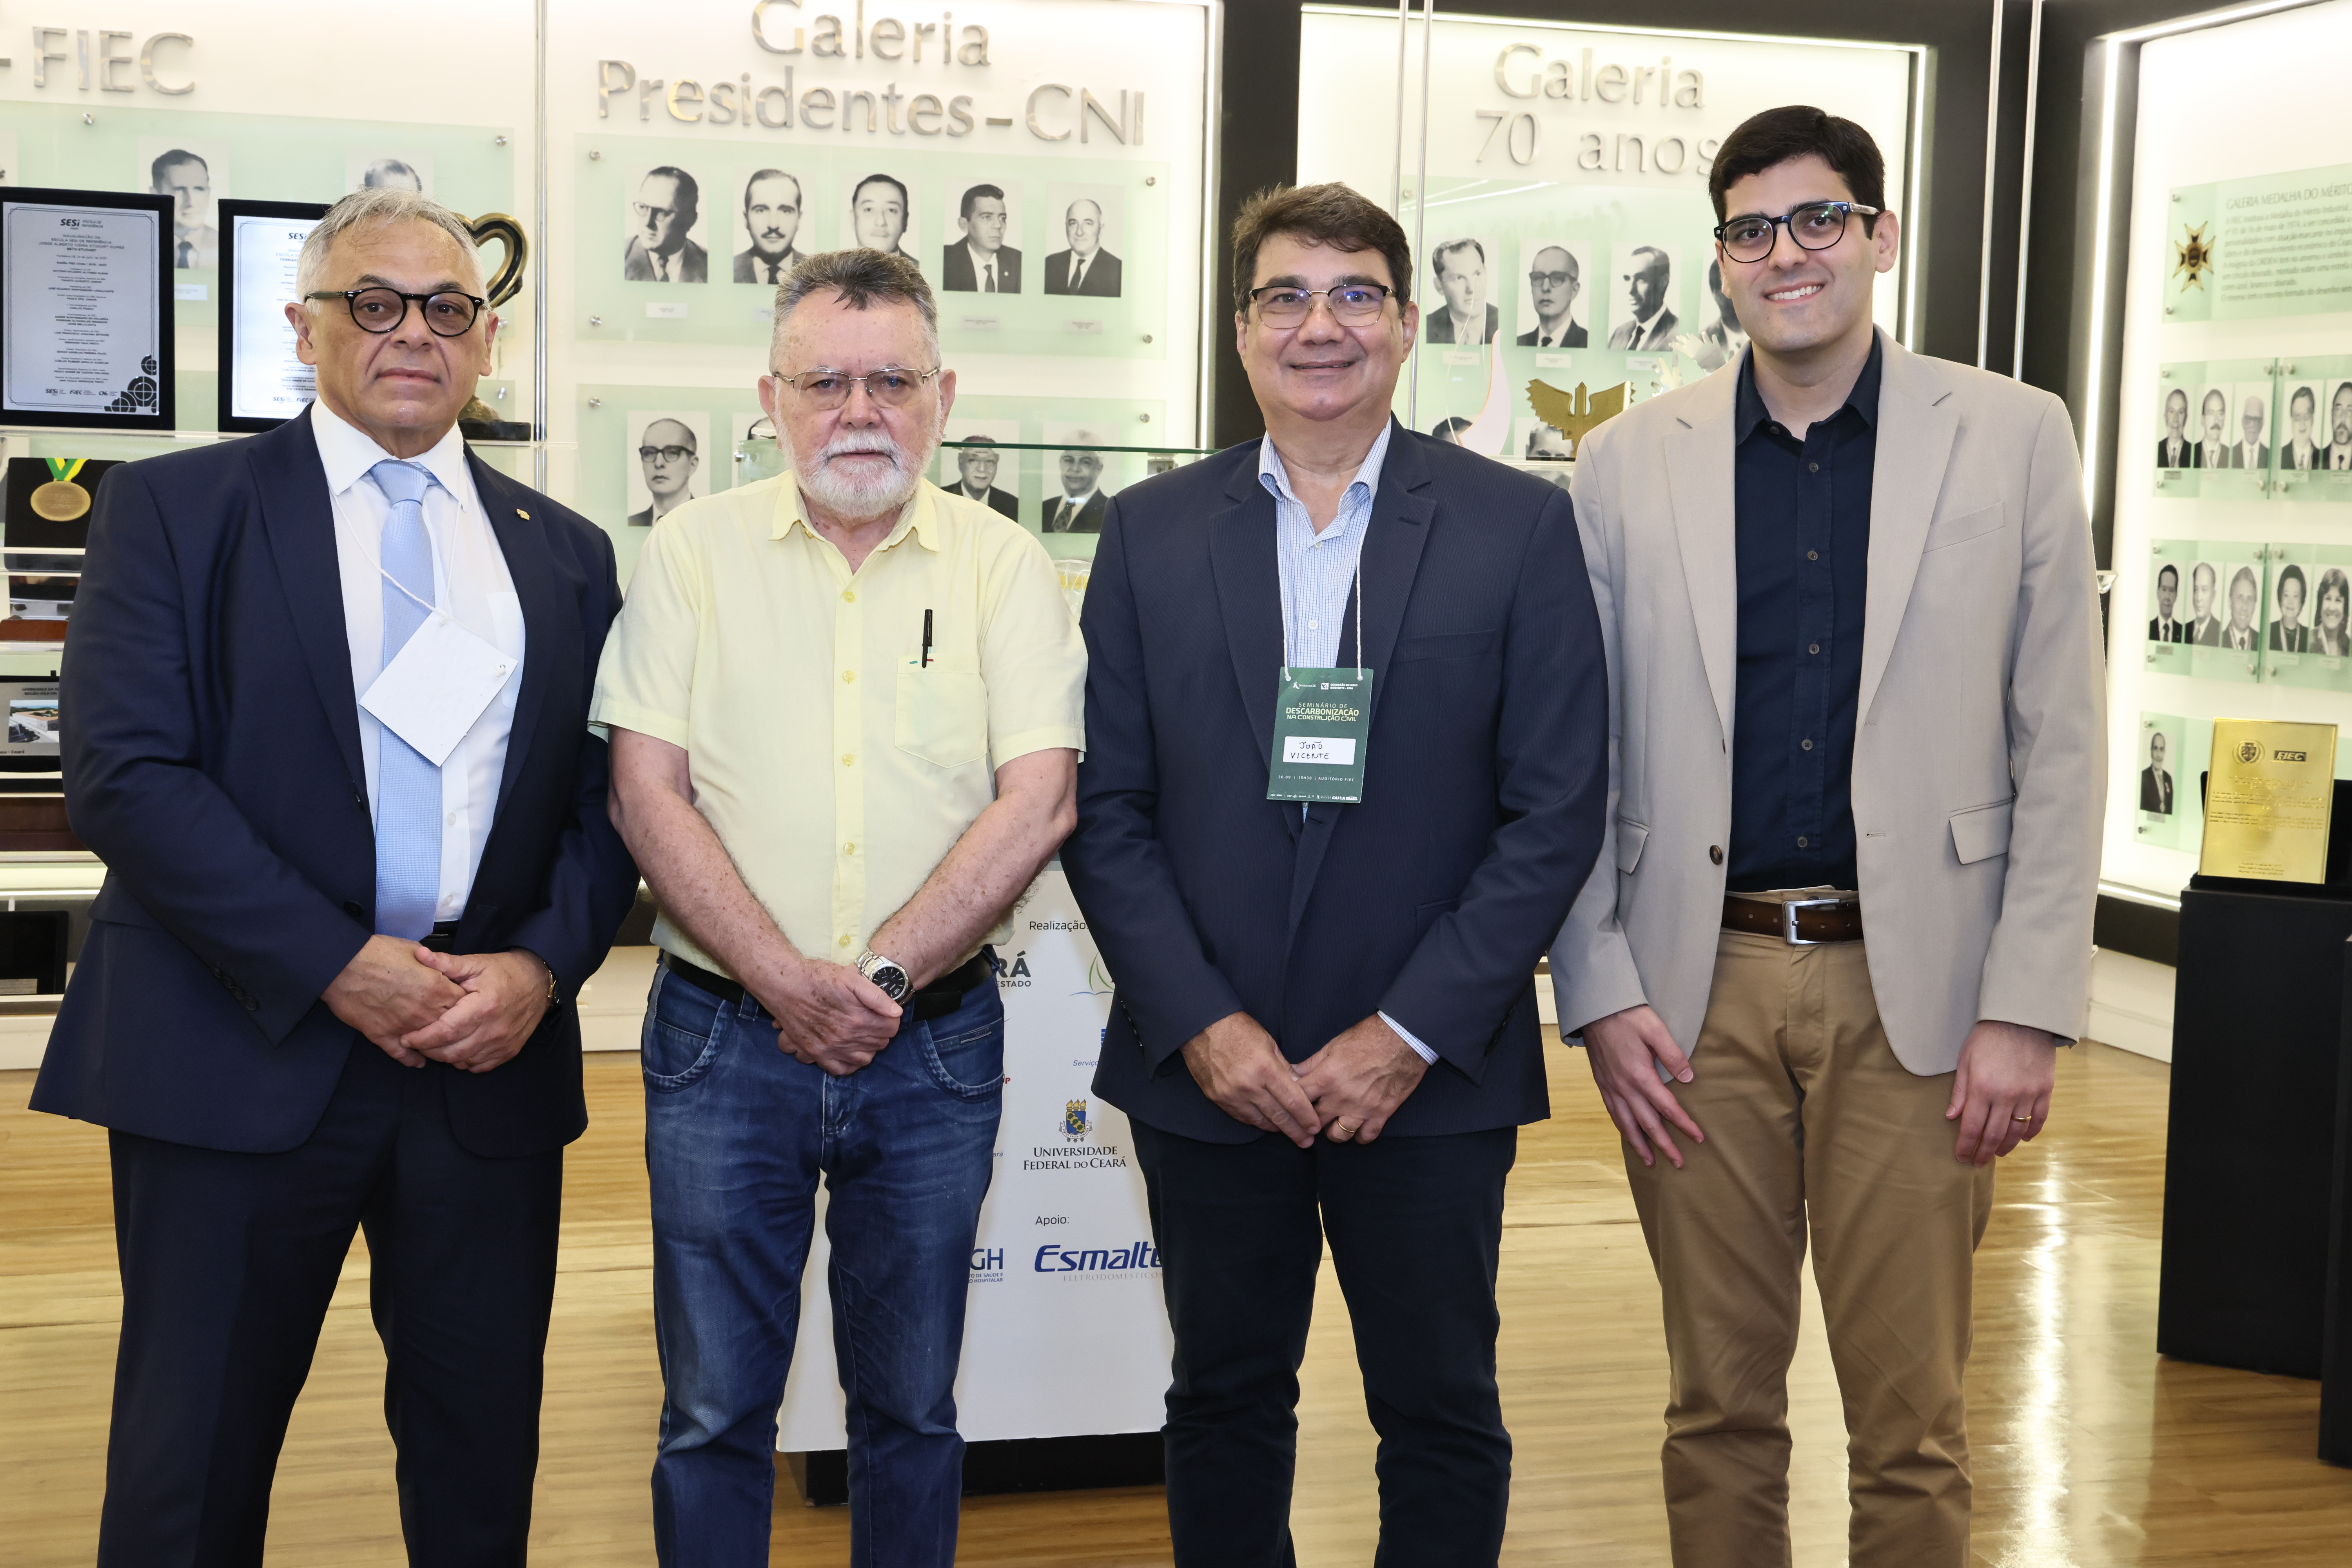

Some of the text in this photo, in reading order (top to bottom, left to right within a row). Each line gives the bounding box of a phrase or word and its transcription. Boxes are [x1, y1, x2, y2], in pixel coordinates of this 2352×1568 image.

[750, 0, 992, 67] Galeria
[33, 26, 196, 96] FIEC
[1494, 42, 1705, 109] Galeria
[597, 59, 975, 138] Presidentes
[1025, 83, 1145, 145] CNI
[1476, 109, 1719, 175] 70 anos
[2303, 187, 2319, 200] DO
[1286, 707, 1359, 717] DESCARBONIZAÇÃO
[2276, 751, 2305, 760] FIEC
[1029, 920, 1088, 932] Realização
[1034, 1147, 1118, 1157] UNIVERSIDADE
[1023, 1160, 1072, 1170] FEDERAL
[1090, 1156, 1127, 1168] CEARÁ
[1035, 1215, 1069, 1226] Apoio:
